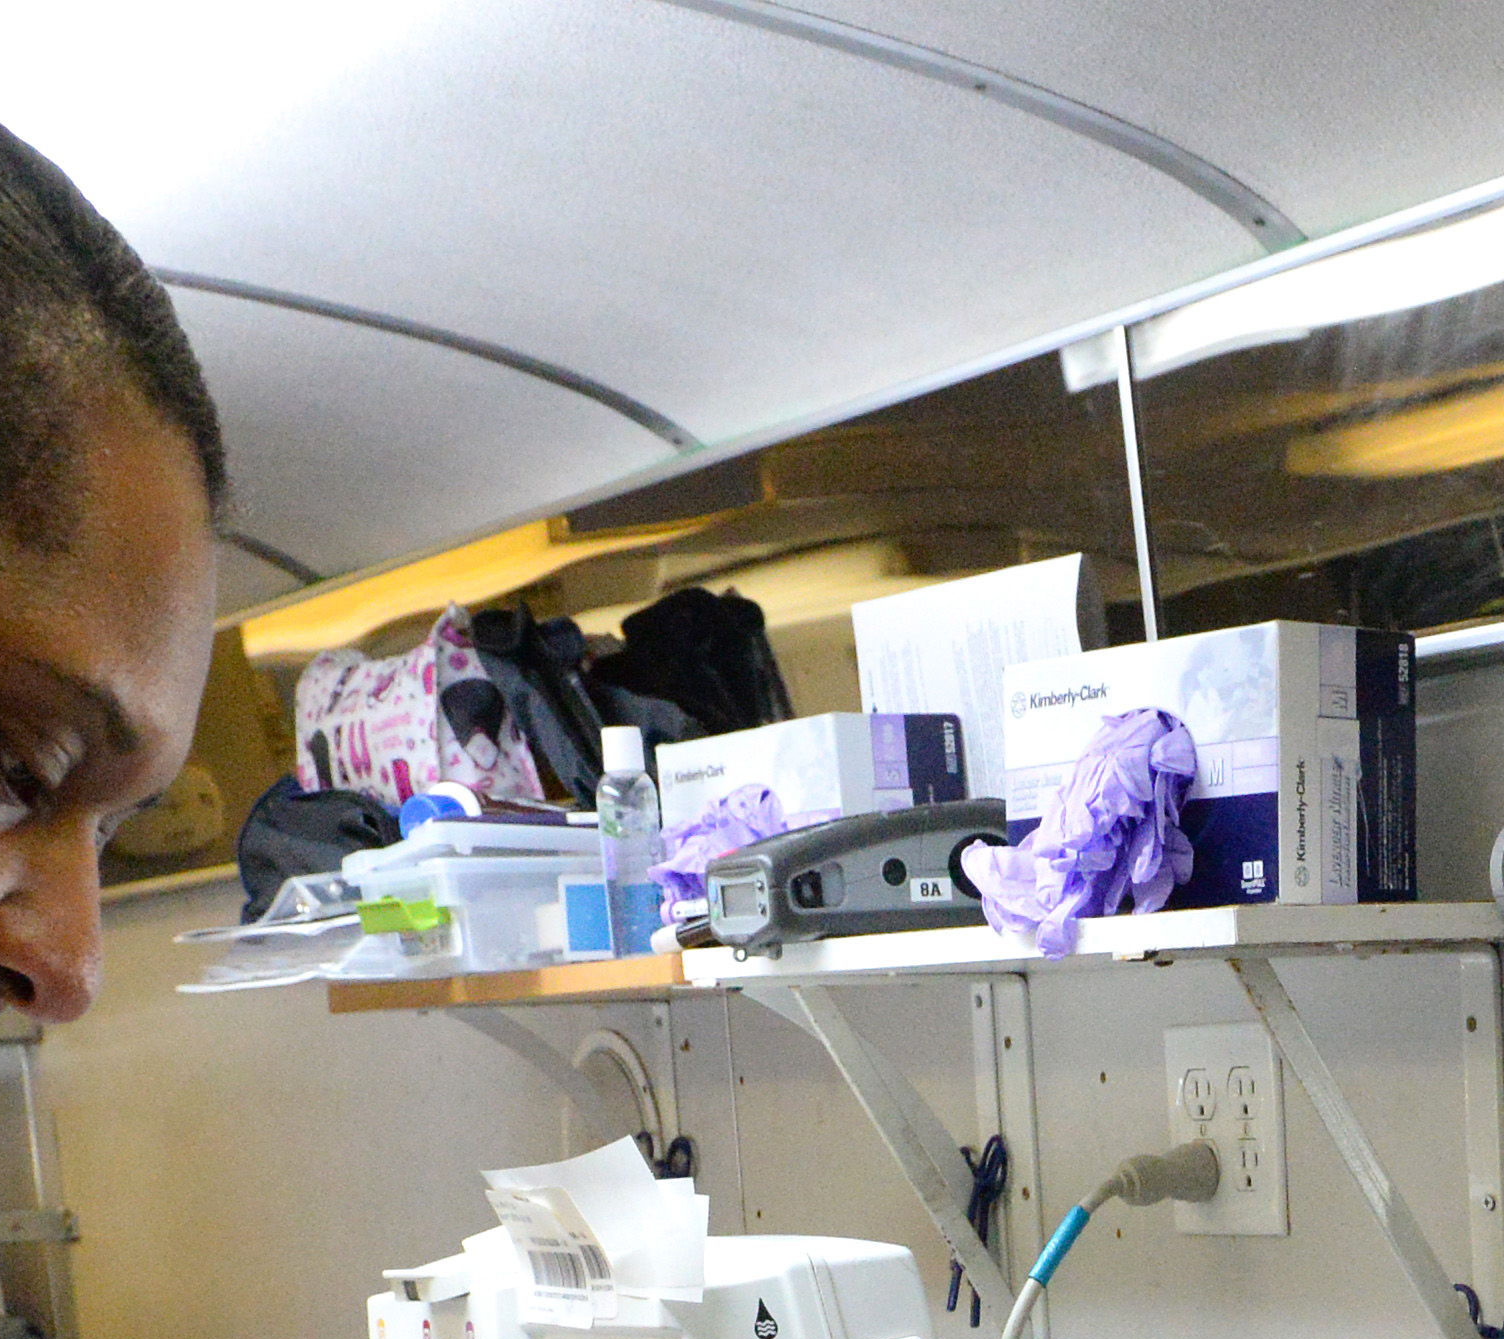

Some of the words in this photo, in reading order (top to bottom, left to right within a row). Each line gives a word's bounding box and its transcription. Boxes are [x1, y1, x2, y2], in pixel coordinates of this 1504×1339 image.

[1029, 683, 1108, 711] Kimberly-Clark
[1208, 757, 1225, 787] M
[1295, 758, 1307, 862] Kimberly-Clark
[920, 882, 942, 897] 8A
